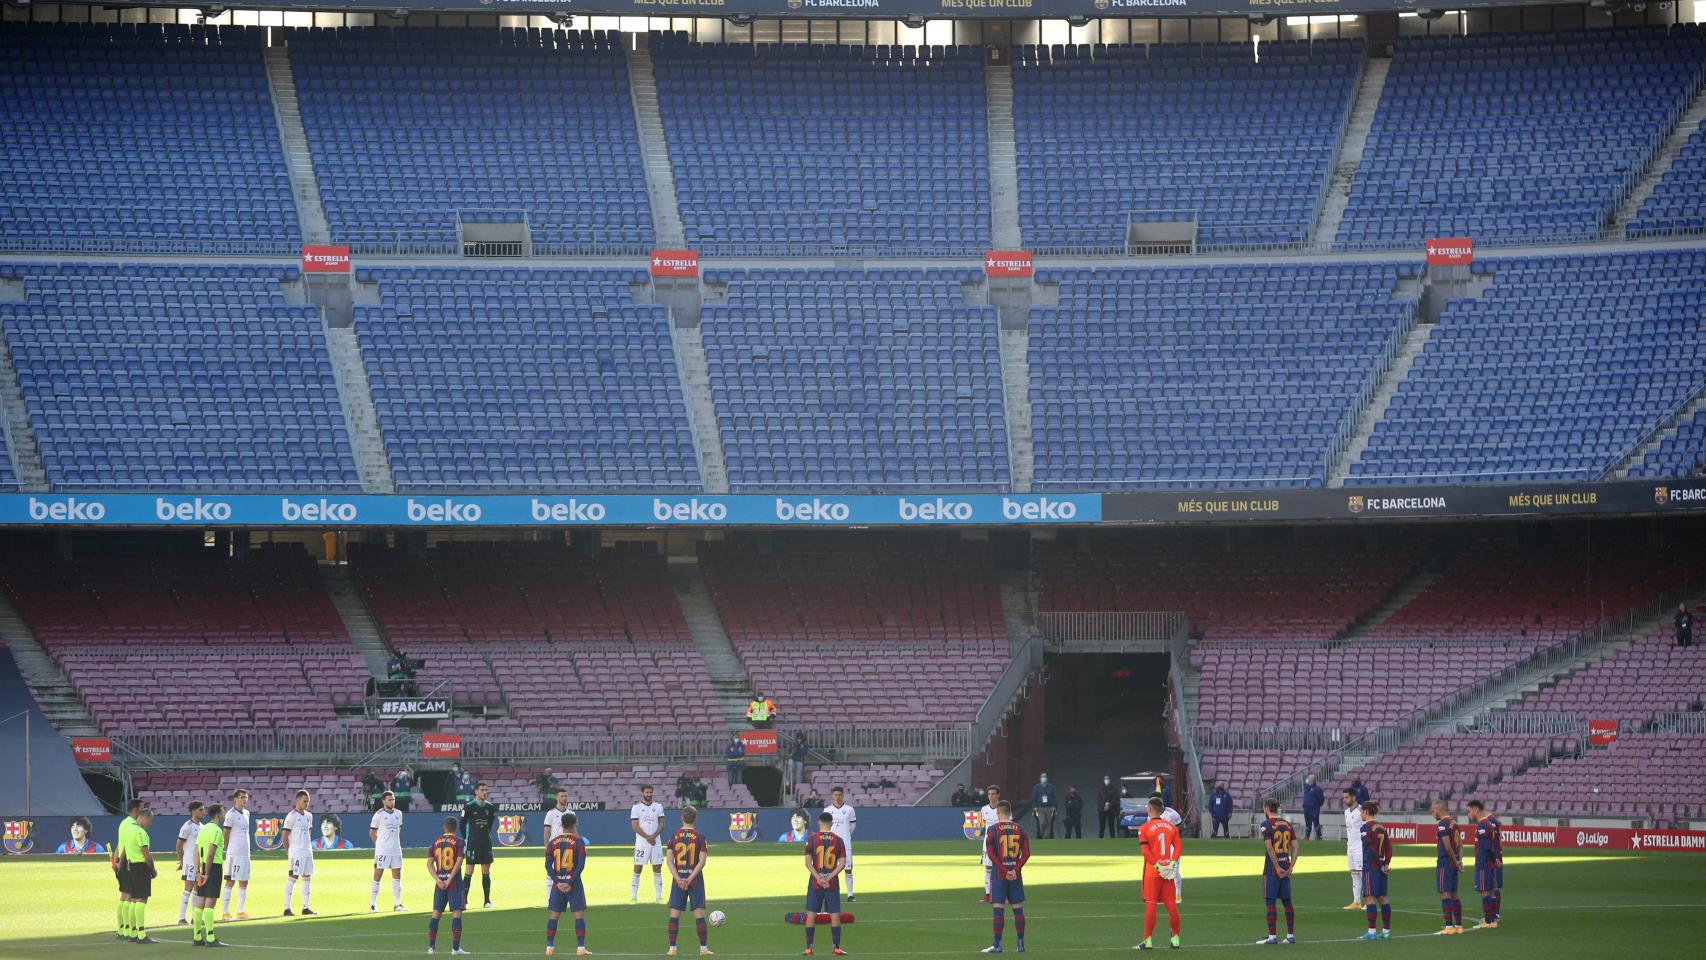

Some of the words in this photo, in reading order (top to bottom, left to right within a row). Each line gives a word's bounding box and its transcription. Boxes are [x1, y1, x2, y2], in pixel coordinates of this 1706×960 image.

[1508, 493, 1531, 507] MÉS
[1532, 494, 1553, 507] QUE
[1555, 494, 1570, 505] UN
[1571, 492, 1597, 505] CLUB
[1670, 490, 1682, 501] FC
[29, 498, 105, 521] beko
[156, 498, 232, 521] beko
[281, 499, 357, 522] beko
[407, 499, 482, 522] beko
[531, 498, 605, 521] beko
[653, 499, 727, 521] beko
[776, 499, 849, 521] beko
[899, 498, 972, 521] beko
[1002, 498, 1076, 520] beko
[1178, 499, 1203, 513] MÉS
[1205, 501, 1229, 514] QUE
[1231, 501, 1248, 512] UN
[1250, 500, 1280, 512] CLUB
[1367, 499, 1381, 510] FC
[1382, 497, 1446, 509] BARCELONA
[382, 701, 446, 712] #FANCAM
[499, 803, 541, 811] #FANCAM
[1395, 827, 1415, 839] DAMM
[1501, 830, 1533, 843] STRELLA
[1533, 831, 1555, 844] DAMM
[1586, 832, 1609, 846] LaLiga
[1001, 834, 1021, 858] 15
[1157, 832, 1166, 857] 1
[1274, 830, 1290, 854] 28
[1643, 834, 1680, 847] ESTRELLA
[1680, 835, 1705, 848] DAMM
[434, 847, 455, 871] 18
[553, 848, 575, 872] 14
[636, 850, 645, 858] 22
[675, 842, 696, 866] 21
[816, 845, 836, 870] 16
